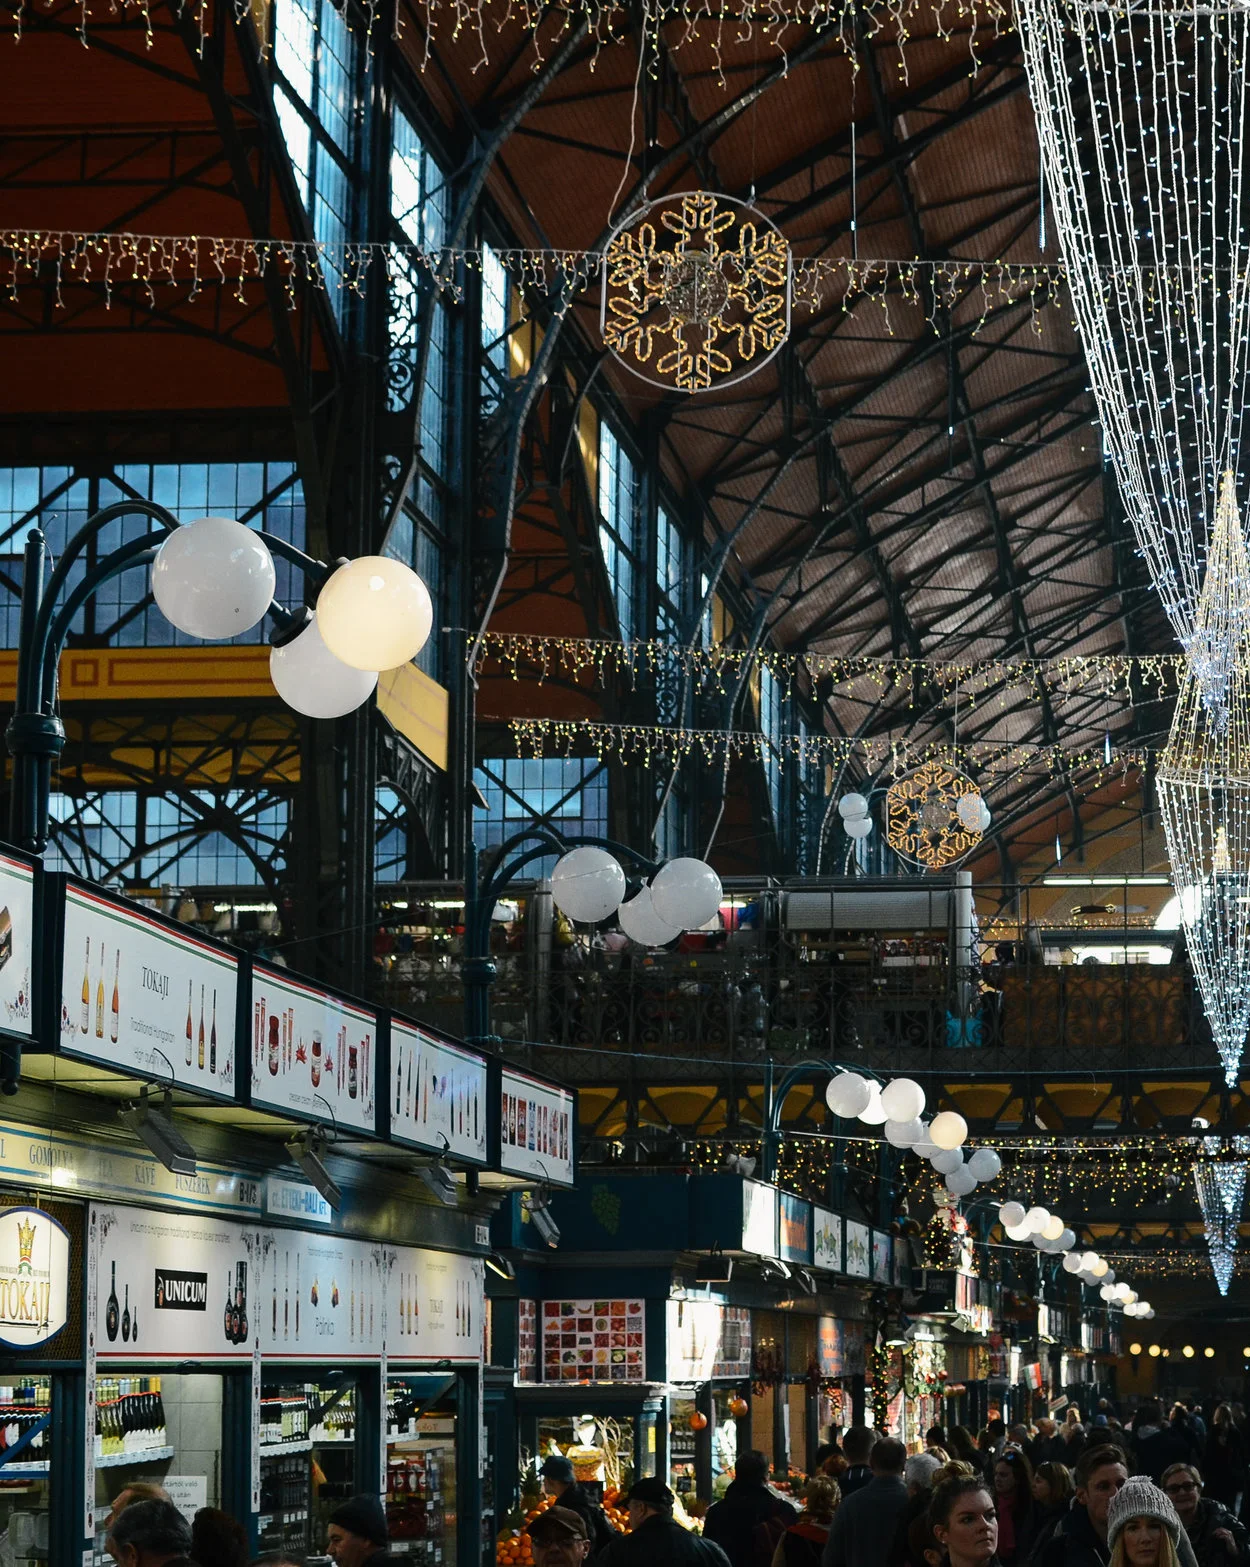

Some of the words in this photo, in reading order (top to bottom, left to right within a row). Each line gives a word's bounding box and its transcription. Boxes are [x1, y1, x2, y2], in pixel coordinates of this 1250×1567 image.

[142, 966, 169, 1000] TOKAJI
[135, 1161, 156, 1186] KÁVÉ
[164, 1279, 207, 1303] UNICUM
[0, 1278, 50, 1335] TOKAJI
